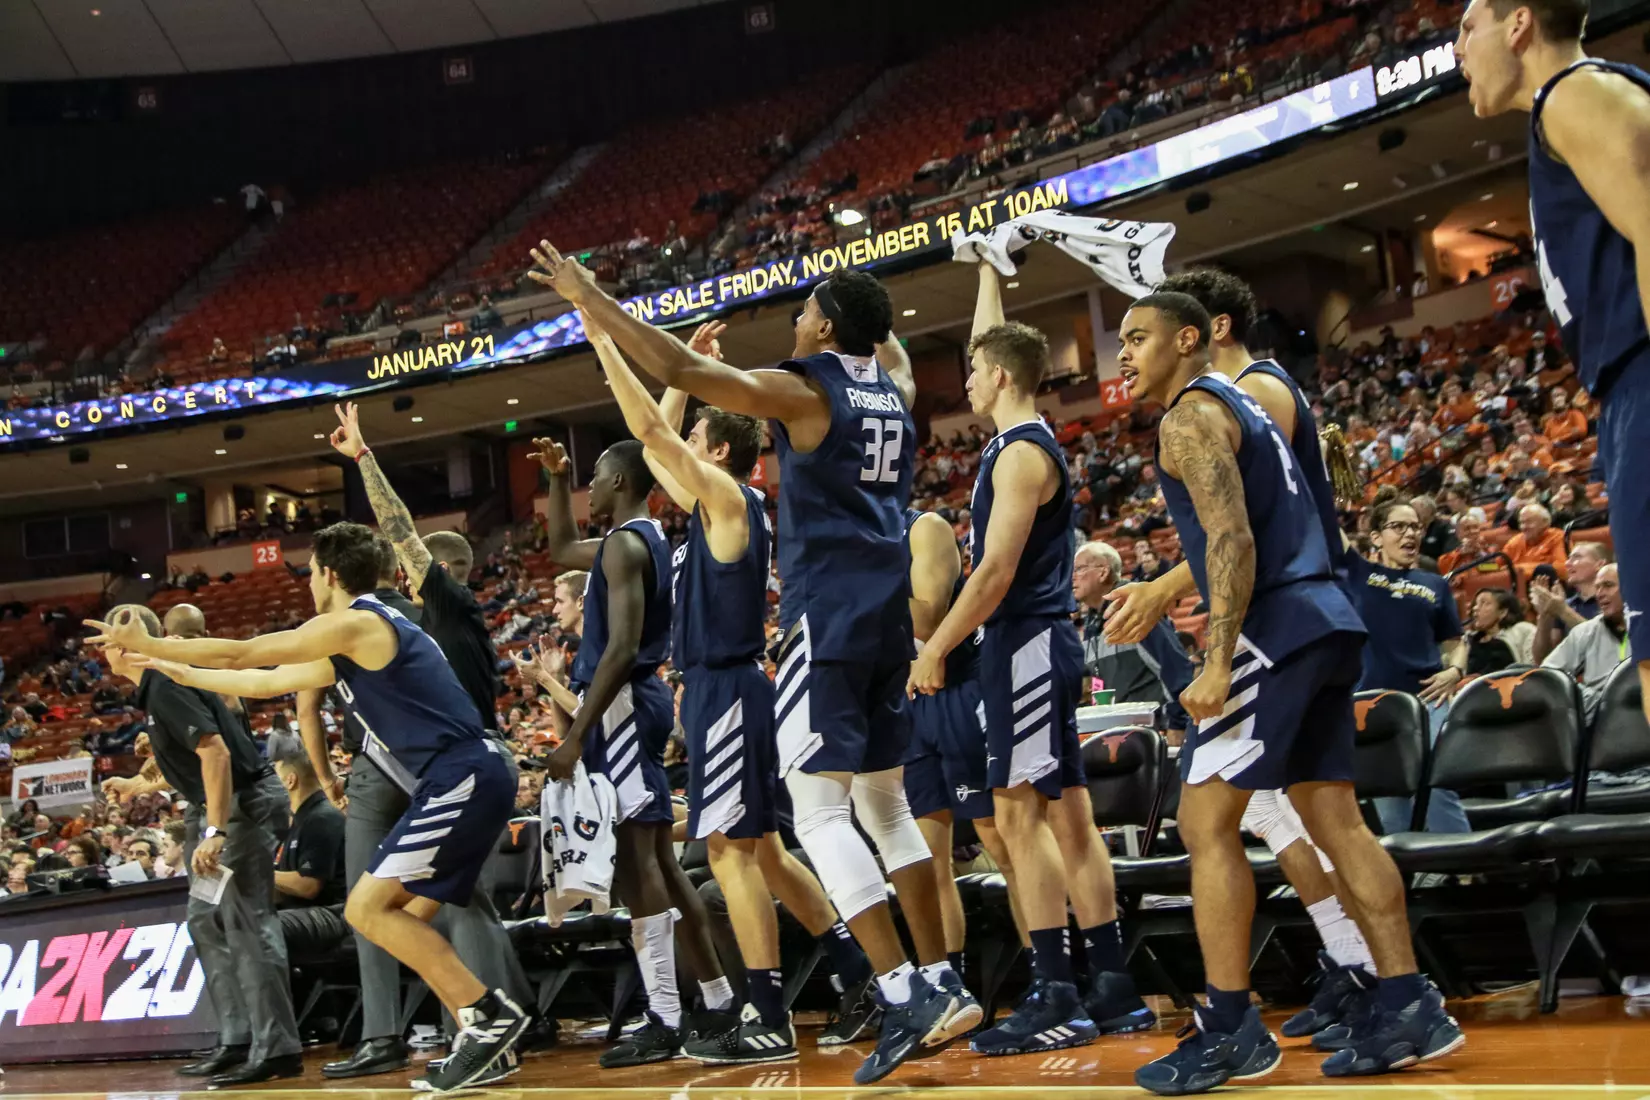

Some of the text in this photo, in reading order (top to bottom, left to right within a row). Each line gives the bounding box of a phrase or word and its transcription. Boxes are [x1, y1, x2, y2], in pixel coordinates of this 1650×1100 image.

[659, 282, 715, 316] SALE
[718, 259, 797, 302] FRIDAY,
[803, 221, 930, 279] NOVEMBER
[967, 200, 1001, 233] AT
[1003, 178, 1069, 220] 10AM
[367, 334, 495, 380] JANUARY 21
[55, 381, 256, 428] CONCERT
[1105, 384, 1129, 404] 21
[860, 417, 904, 483] 32
[750, 463, 762, 481] 2
[256, 545, 278, 564] 23
[44, 781, 87, 795] NETWORK
